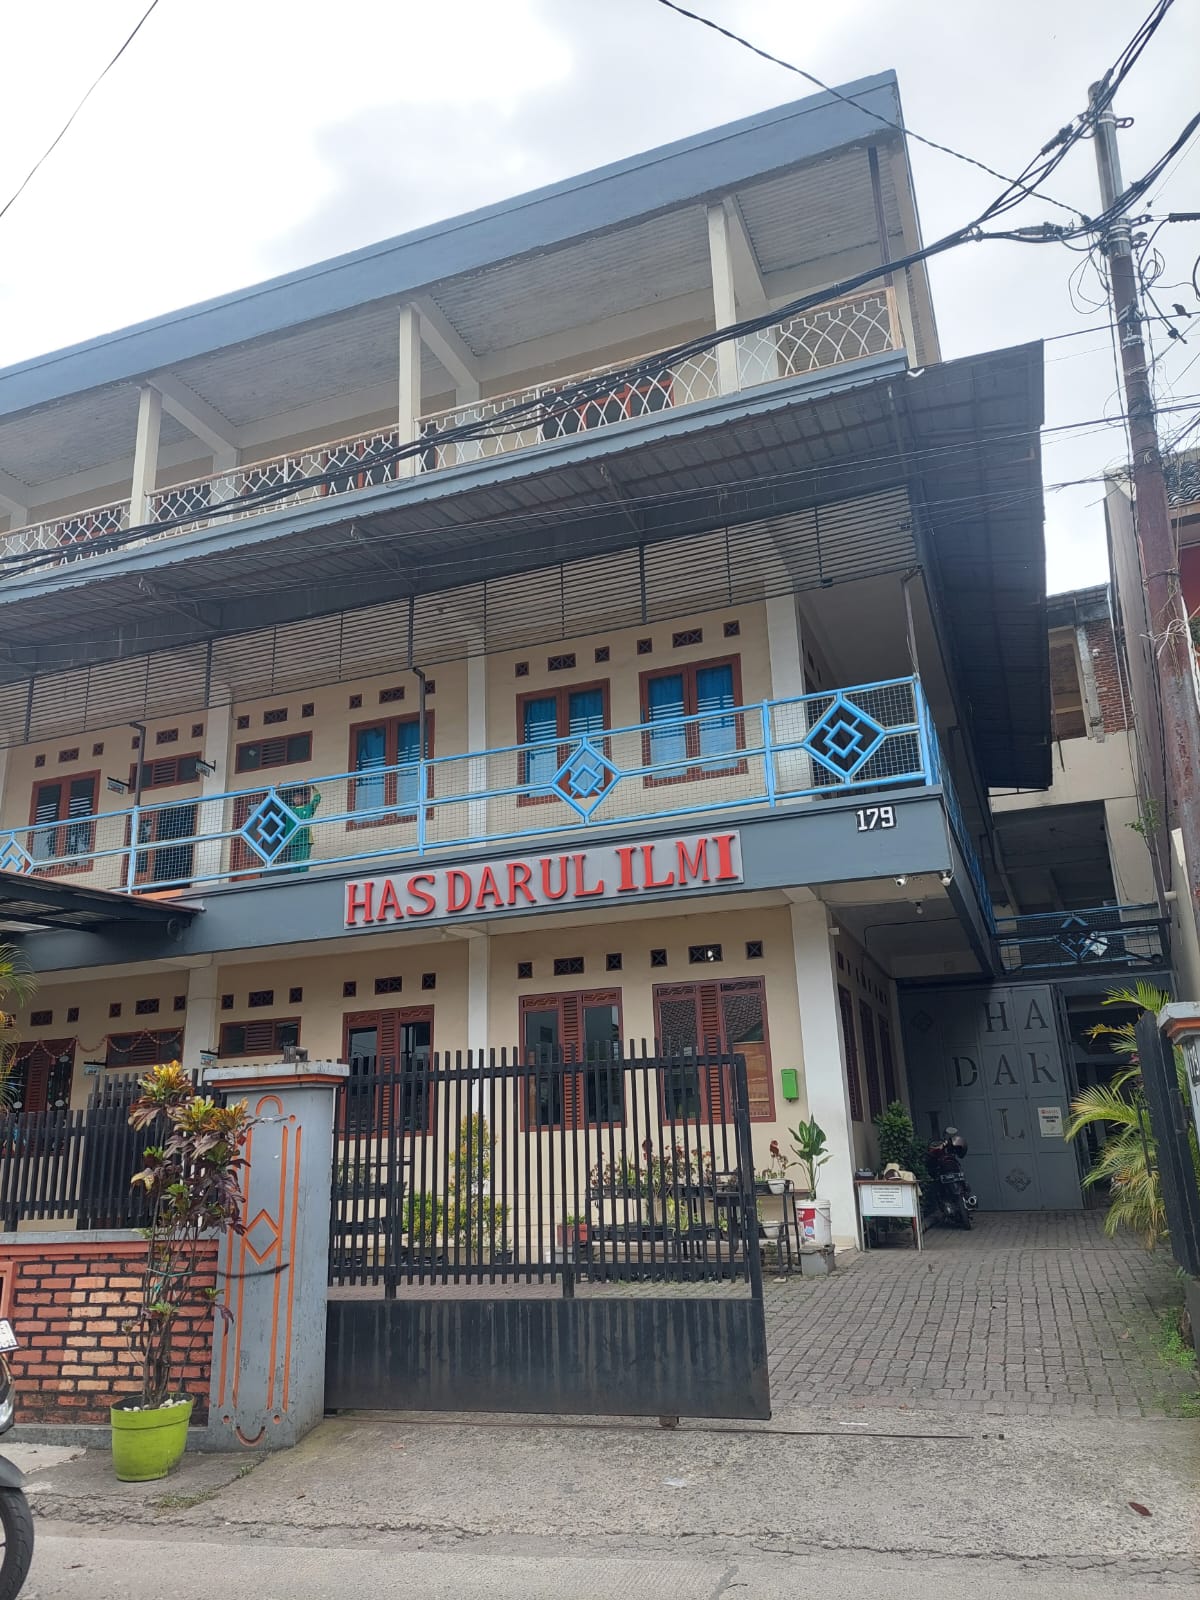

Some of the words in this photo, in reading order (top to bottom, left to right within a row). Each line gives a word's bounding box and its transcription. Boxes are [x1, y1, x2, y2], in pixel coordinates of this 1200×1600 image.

[857, 806, 894, 831] 179
[346, 874, 436, 925] HAS
[445, 854, 605, 912] DARUL
[615, 835, 739, 892] ILMI
